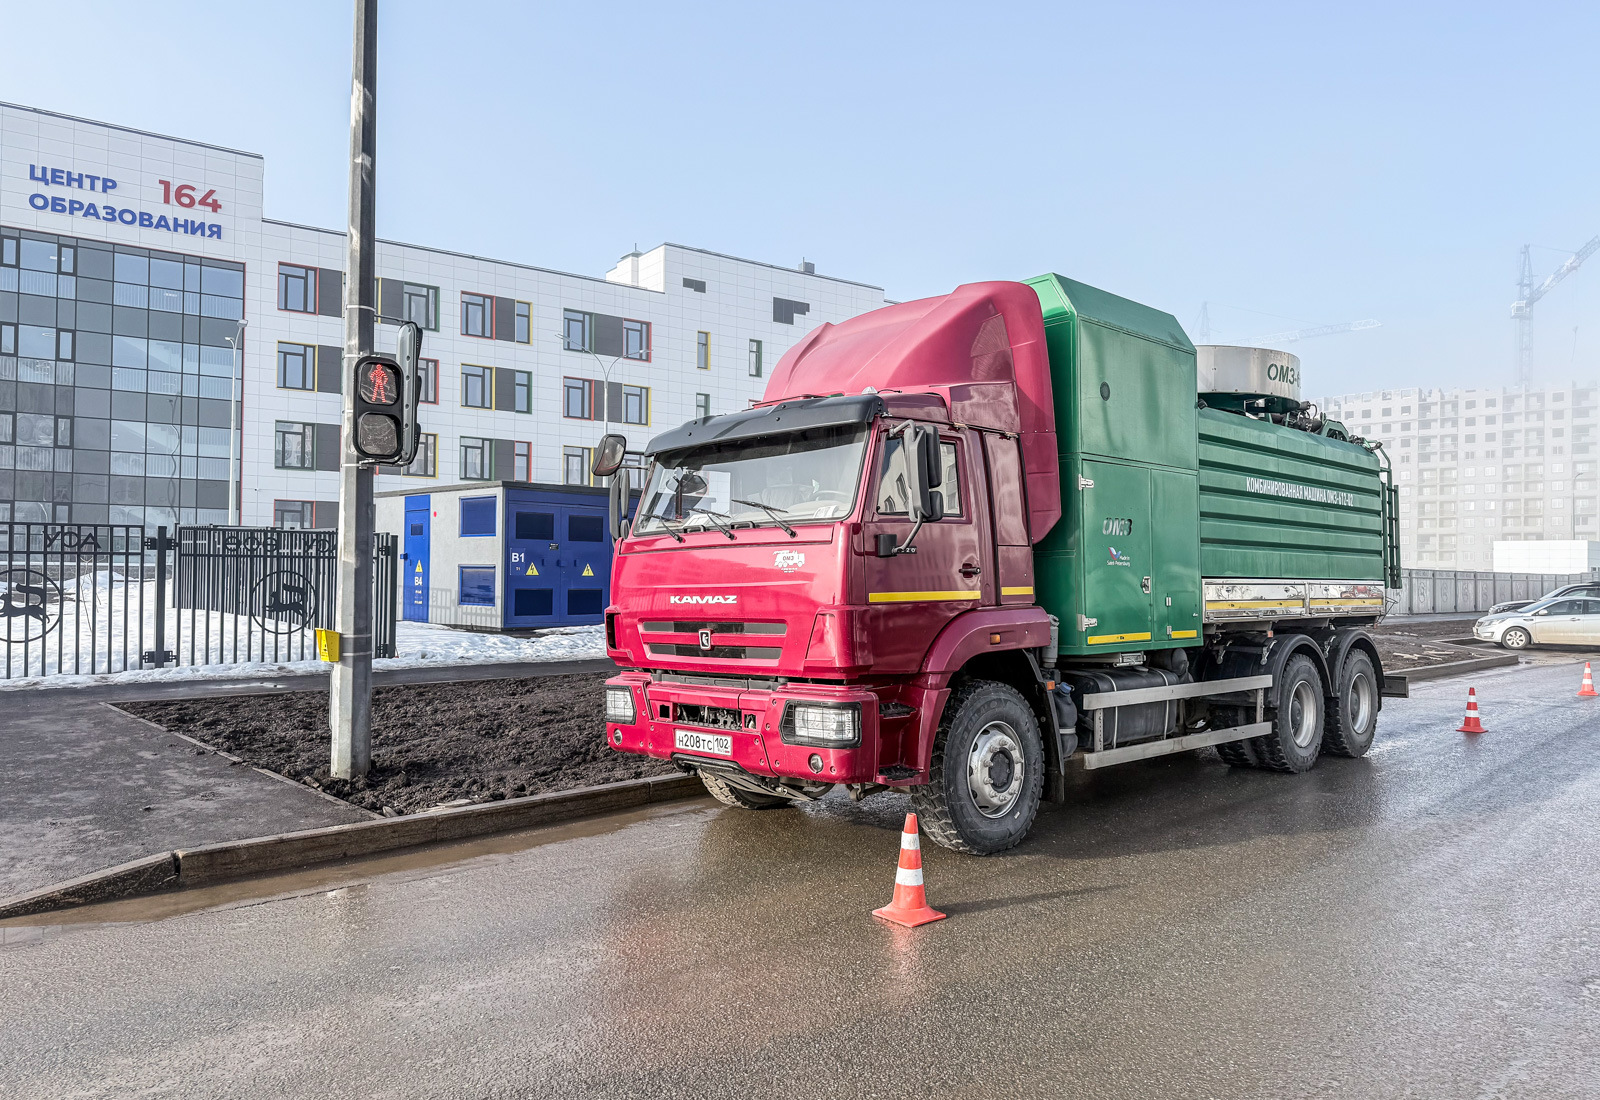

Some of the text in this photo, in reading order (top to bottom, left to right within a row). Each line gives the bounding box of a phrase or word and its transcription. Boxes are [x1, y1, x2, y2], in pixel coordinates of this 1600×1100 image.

[29, 163, 118, 193] ЦЕНТР
[158, 179, 223, 213] 164
[28, 193, 223, 240] ОБРАЗОВАНИЯ
[1246, 476, 1304, 500] КОМБИНИРОВАННАЯ
[1304, 486, 1327, 503] МАШИНА
[1102, 517, 1133, 536] ОМЗ
[42, 531, 102, 549] УФА
[670, 595, 738, 604] KAMAZ
[678, 734, 729, 751] Н208ТС 102
